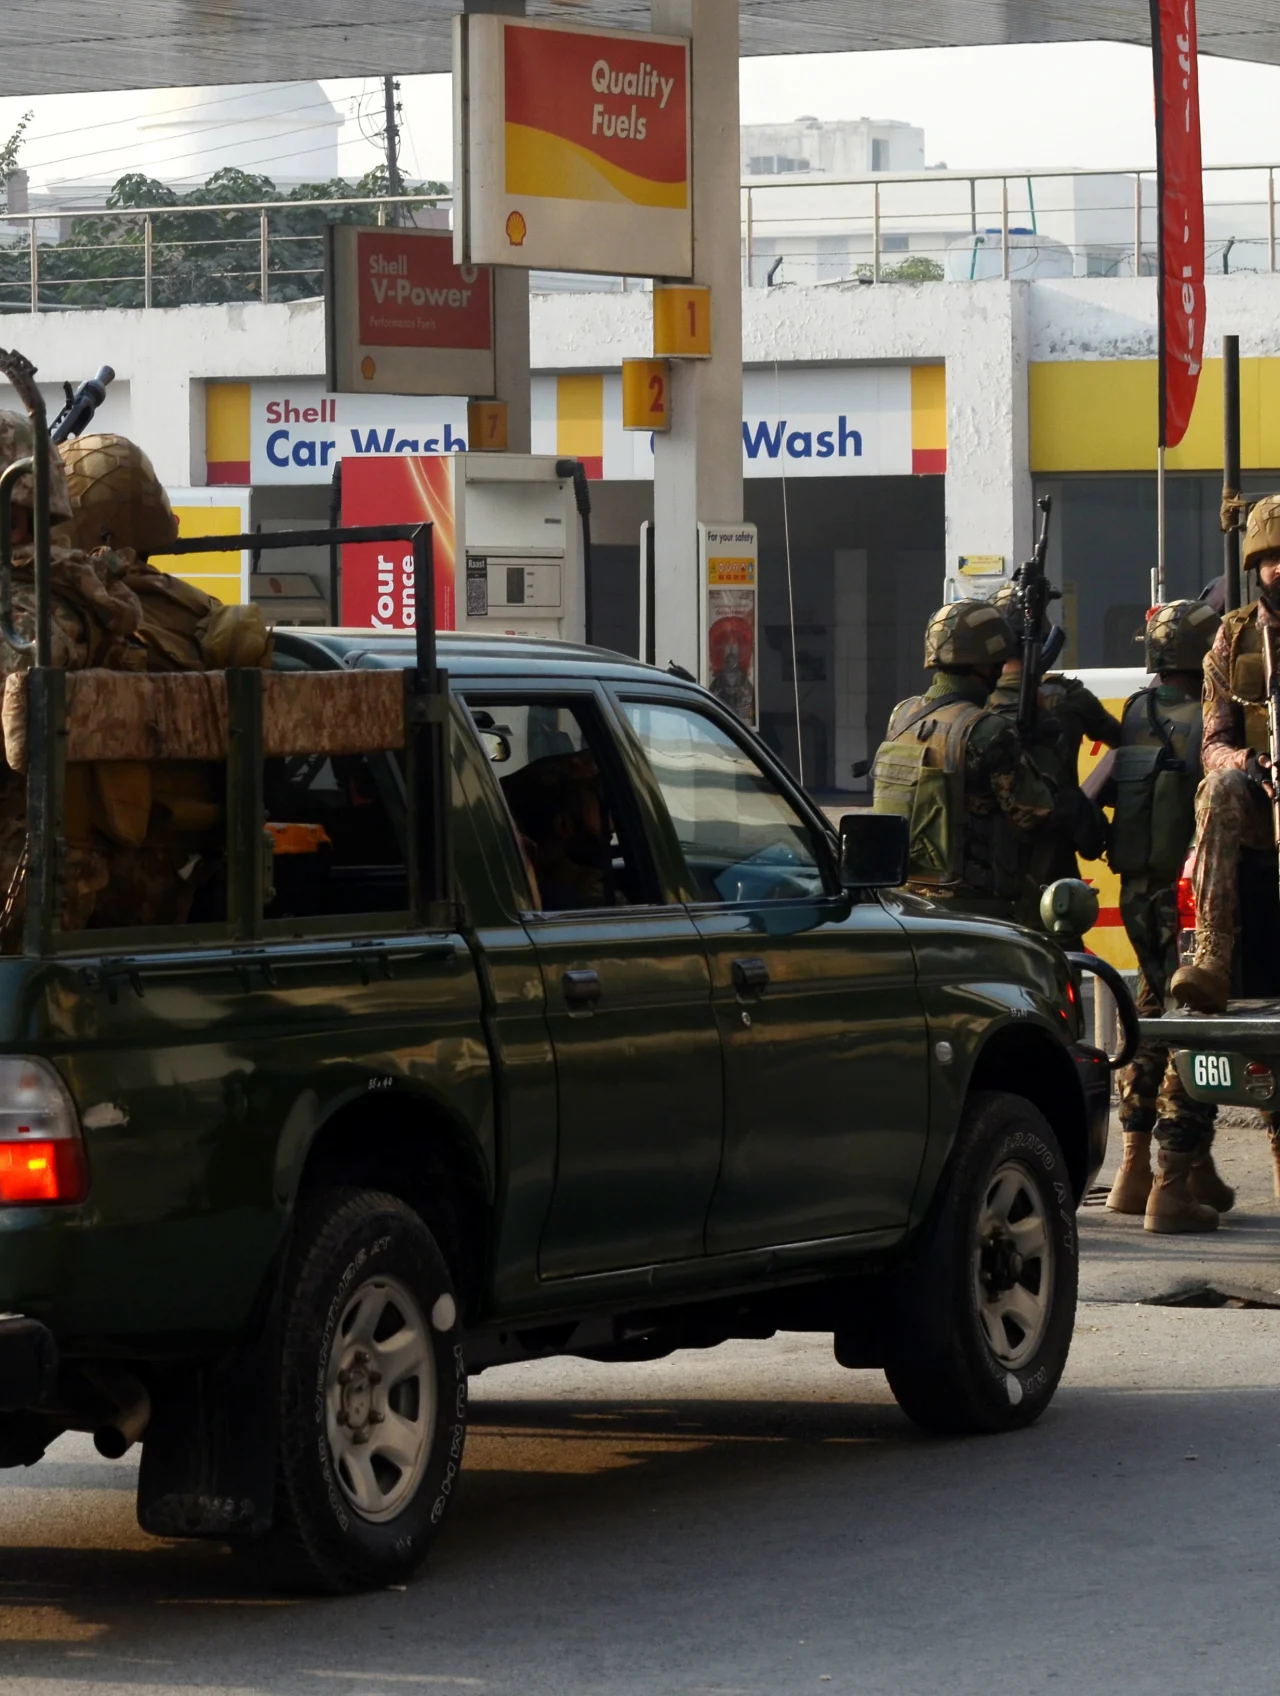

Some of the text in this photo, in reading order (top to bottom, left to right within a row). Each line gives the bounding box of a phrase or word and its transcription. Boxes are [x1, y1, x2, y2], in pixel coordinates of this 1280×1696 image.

[591, 59, 675, 108] Quality
[592, 103, 647, 140] Fuels
[369, 254, 408, 275] Shell
[371, 278, 473, 307] V-Power
[686, 300, 696, 338] 1
[266, 399, 336, 424] Shell
[648, 375, 664, 413] 2
[487, 414, 500, 439] 7
[742, 415, 863, 459] Wash
[266, 424, 467, 468] Car Wash
[707, 532, 754, 545] For your safety
[468, 559, 485, 569] Raast
[402, 554, 417, 631] ance
[1194, 1055, 1232, 1087] 660
[431, 1342, 467, 1524] KUMHO
